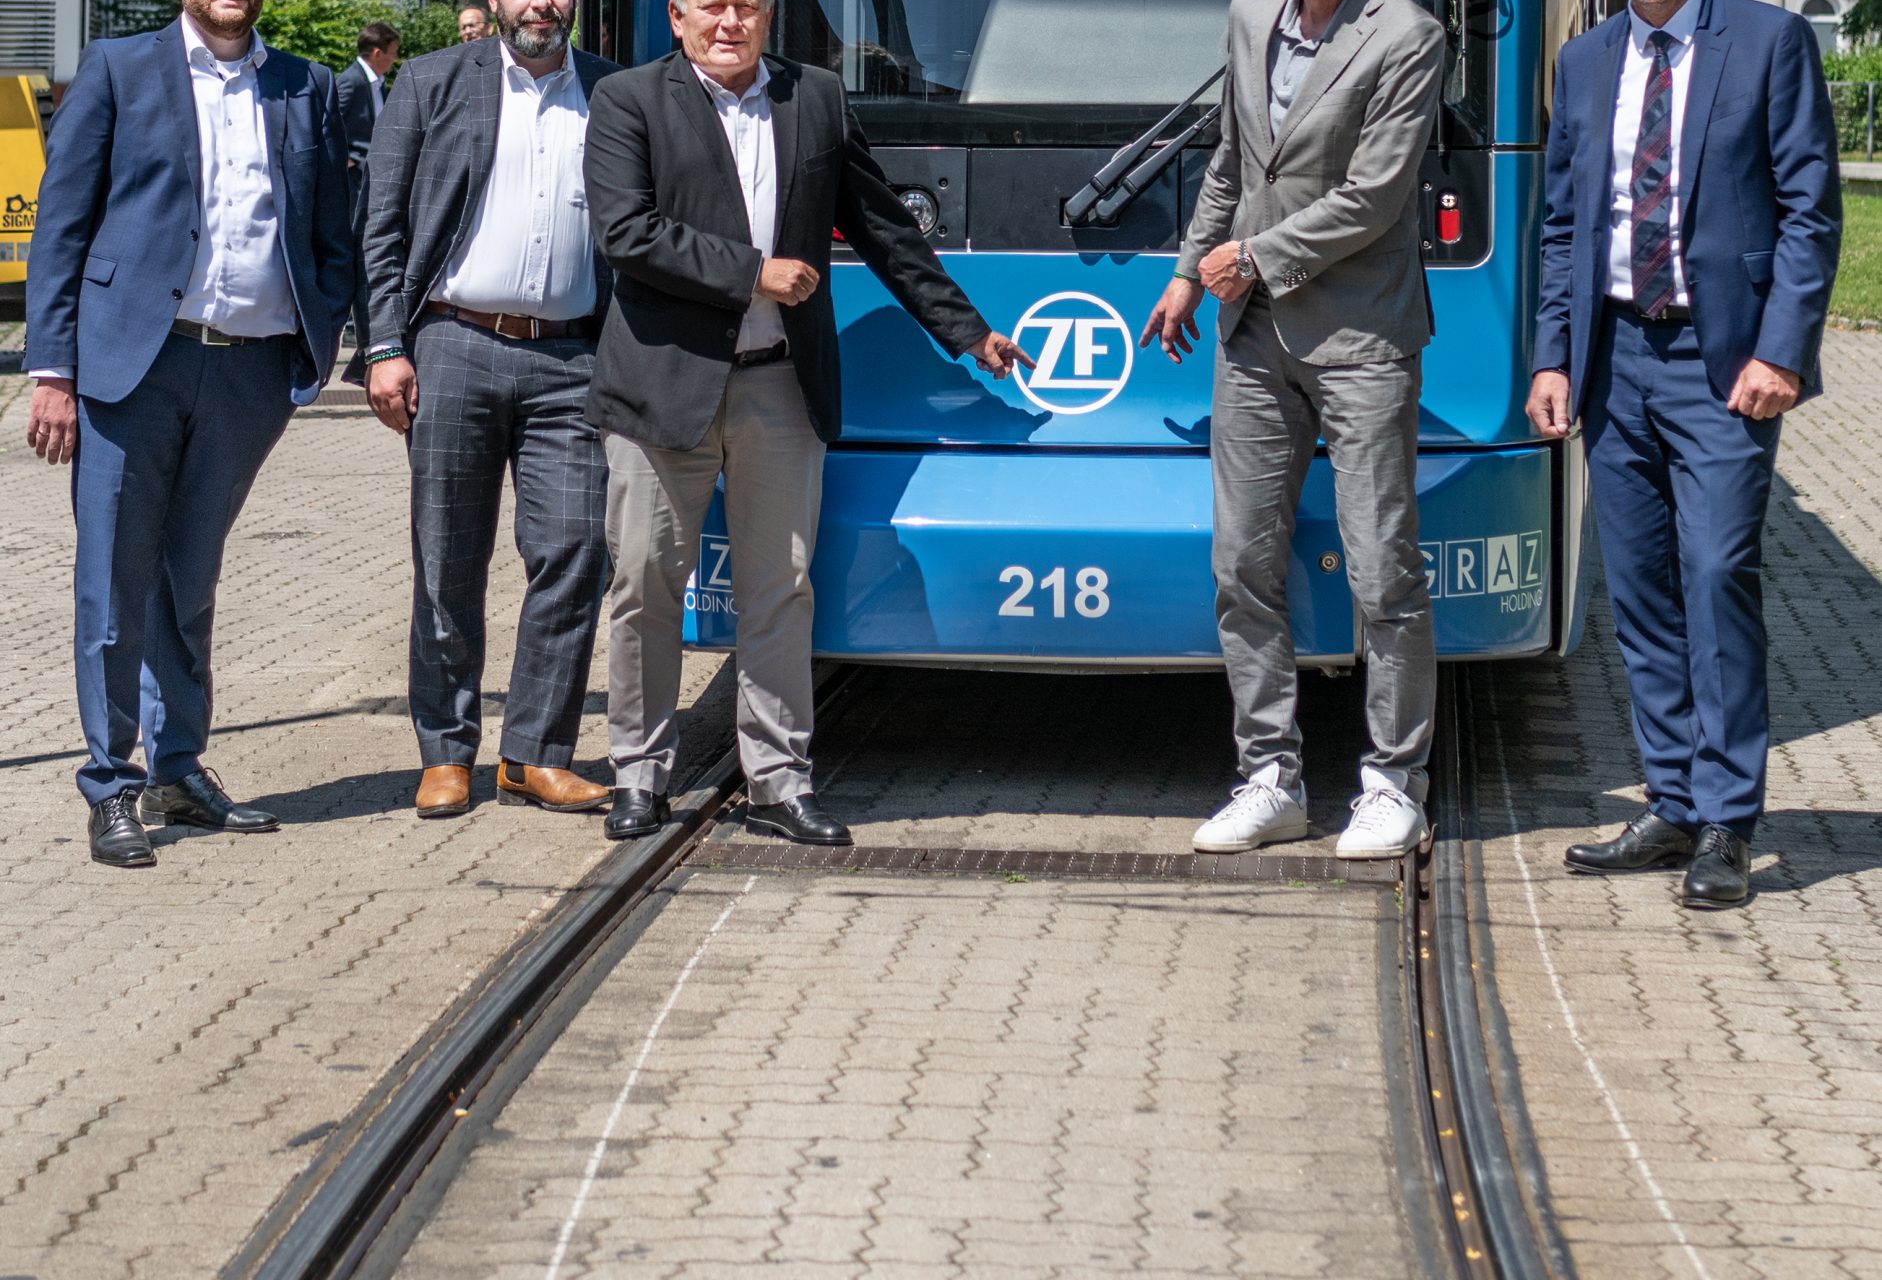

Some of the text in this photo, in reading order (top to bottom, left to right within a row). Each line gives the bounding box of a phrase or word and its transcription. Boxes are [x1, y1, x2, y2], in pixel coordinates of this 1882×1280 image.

[3, 214, 35, 228] SIGM
[1020, 316, 1128, 390] ZF
[684, 591, 739, 616] OLDIN
[998, 566, 1110, 618] 218
[1500, 588, 1543, 614] HOLDING
